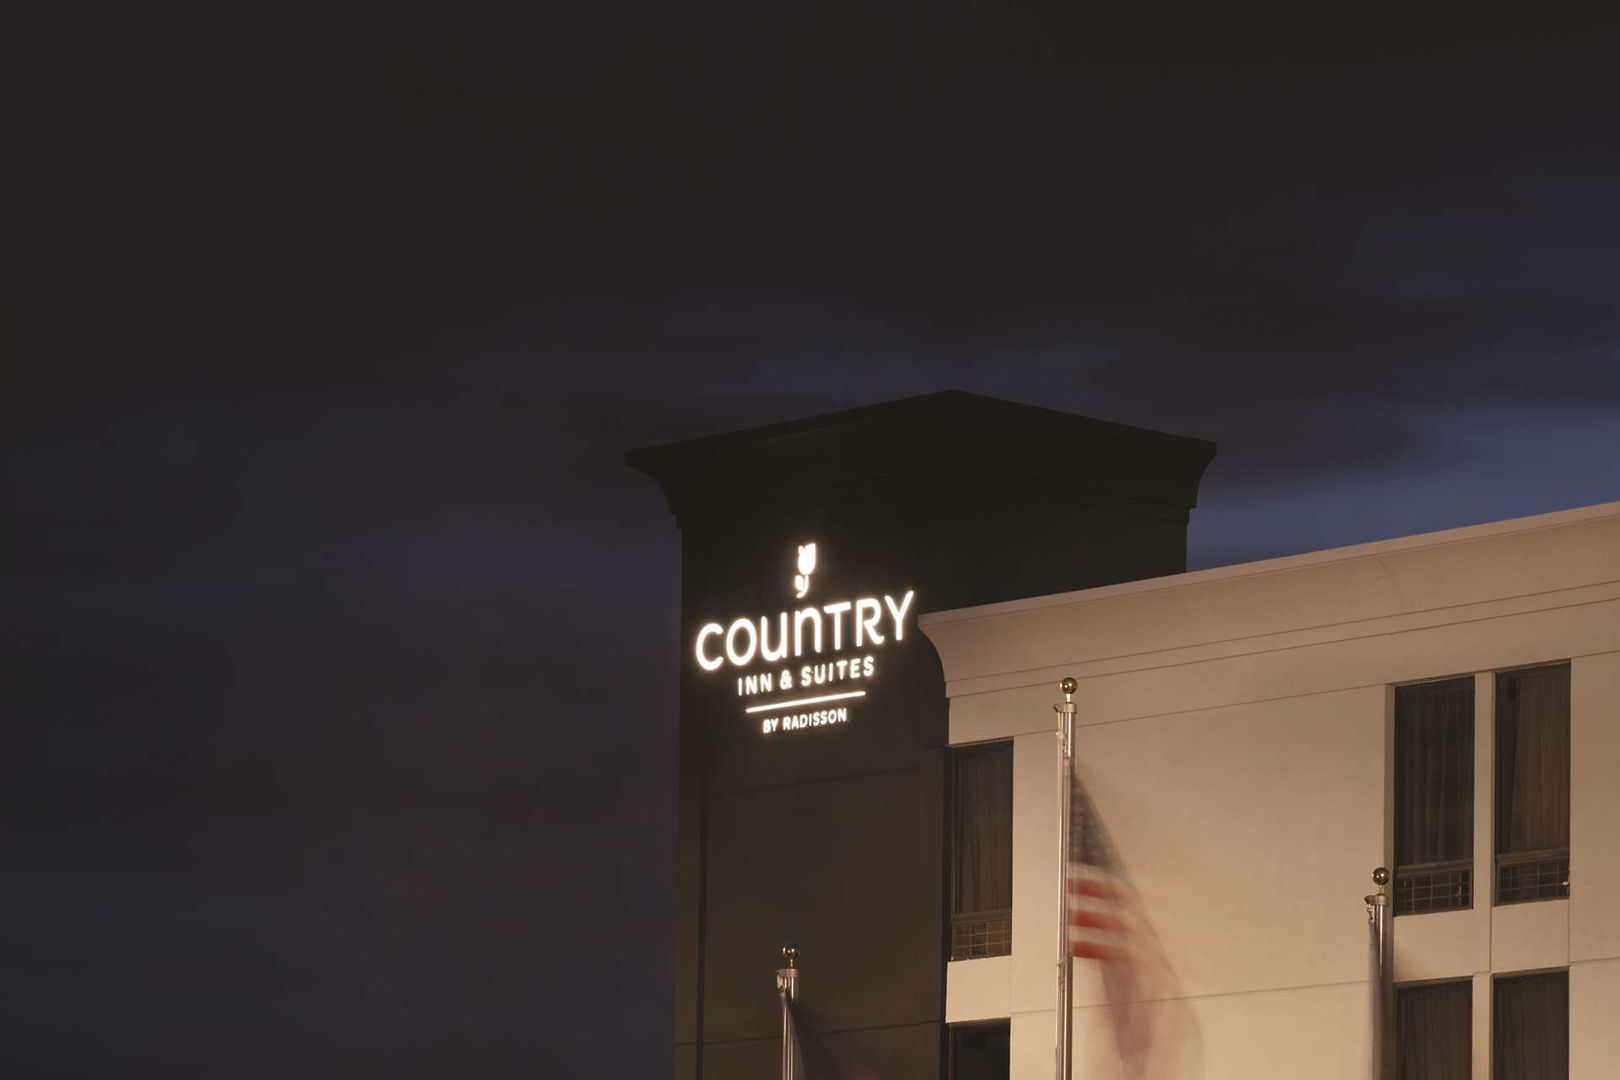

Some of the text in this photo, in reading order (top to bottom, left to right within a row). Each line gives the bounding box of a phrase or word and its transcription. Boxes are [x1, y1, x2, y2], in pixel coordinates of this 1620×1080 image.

[695, 590, 914, 671] COUNTRY
[738, 656, 874, 696] INN & SUITES
[763, 708, 847, 733] BY RADISSON
